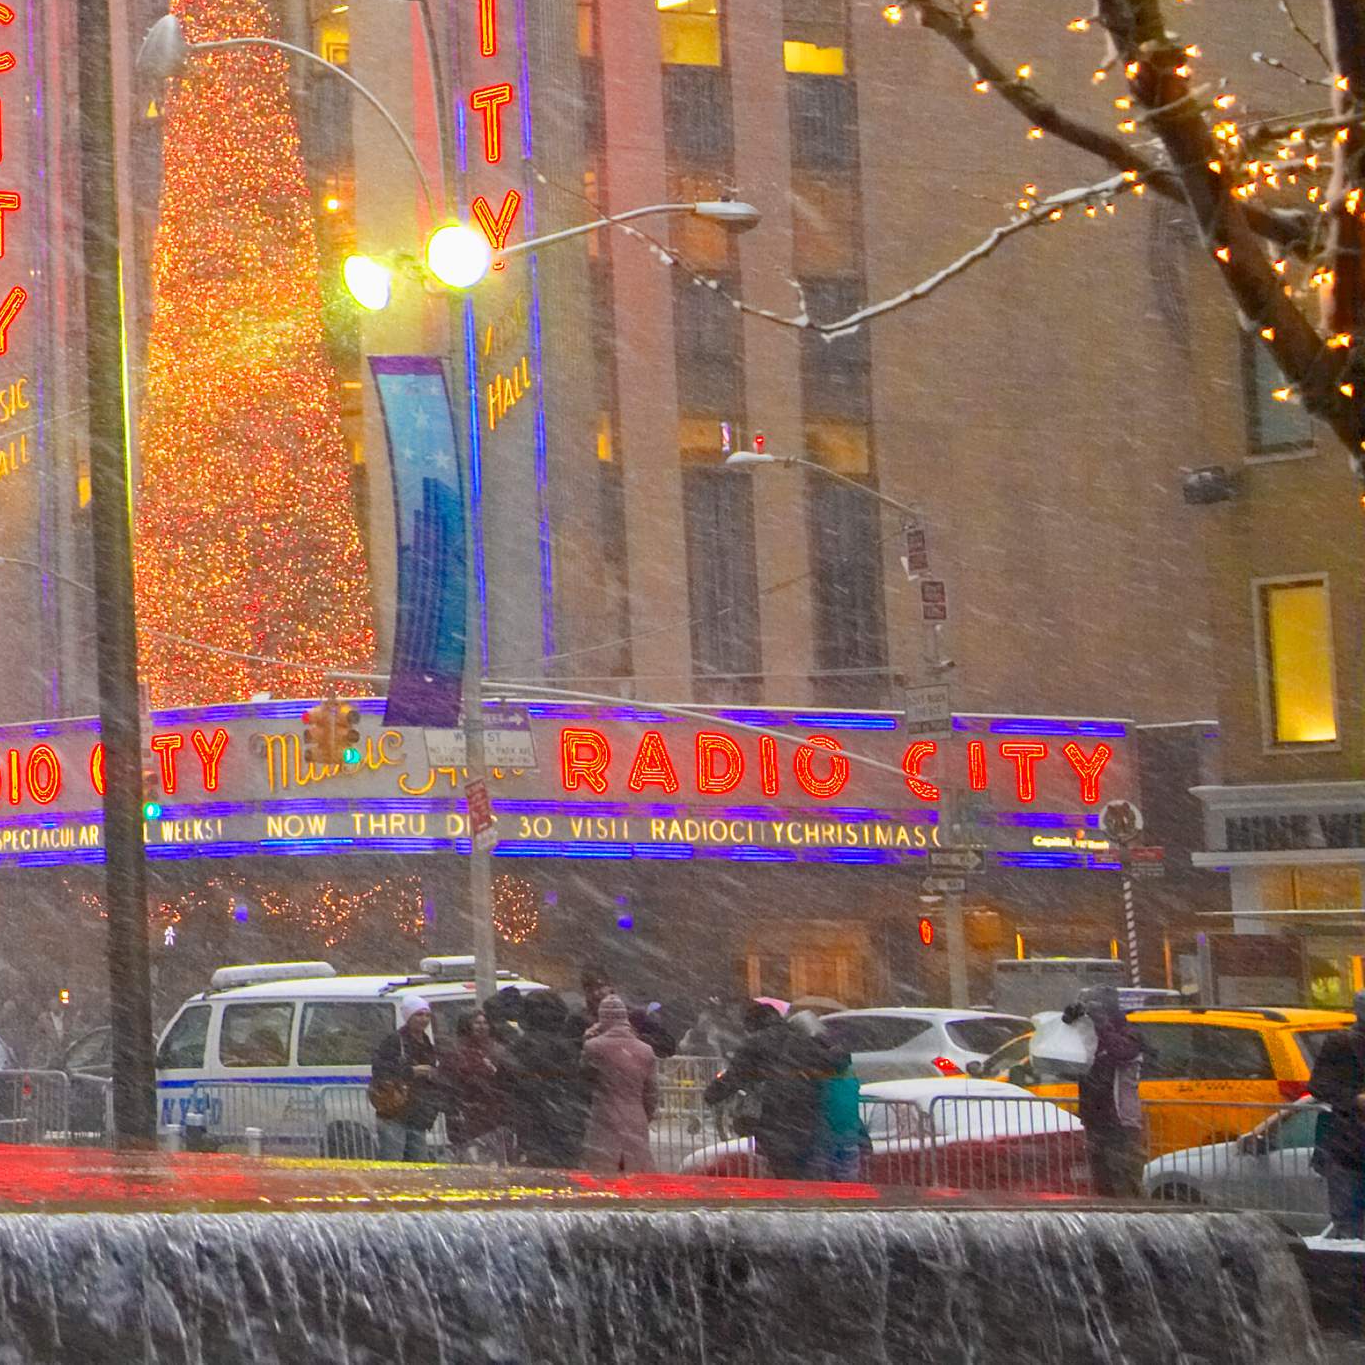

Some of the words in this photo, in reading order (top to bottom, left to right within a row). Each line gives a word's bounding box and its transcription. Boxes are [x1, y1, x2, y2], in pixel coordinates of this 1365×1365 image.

[486, 355, 531, 432] HALL
[561, 728, 851, 801] RADIO
[901, 740, 1113, 805] CITY
[266, 814, 328, 838] NOW
[351, 812, 427, 836] THRU
[518, 815, 553, 839] 30
